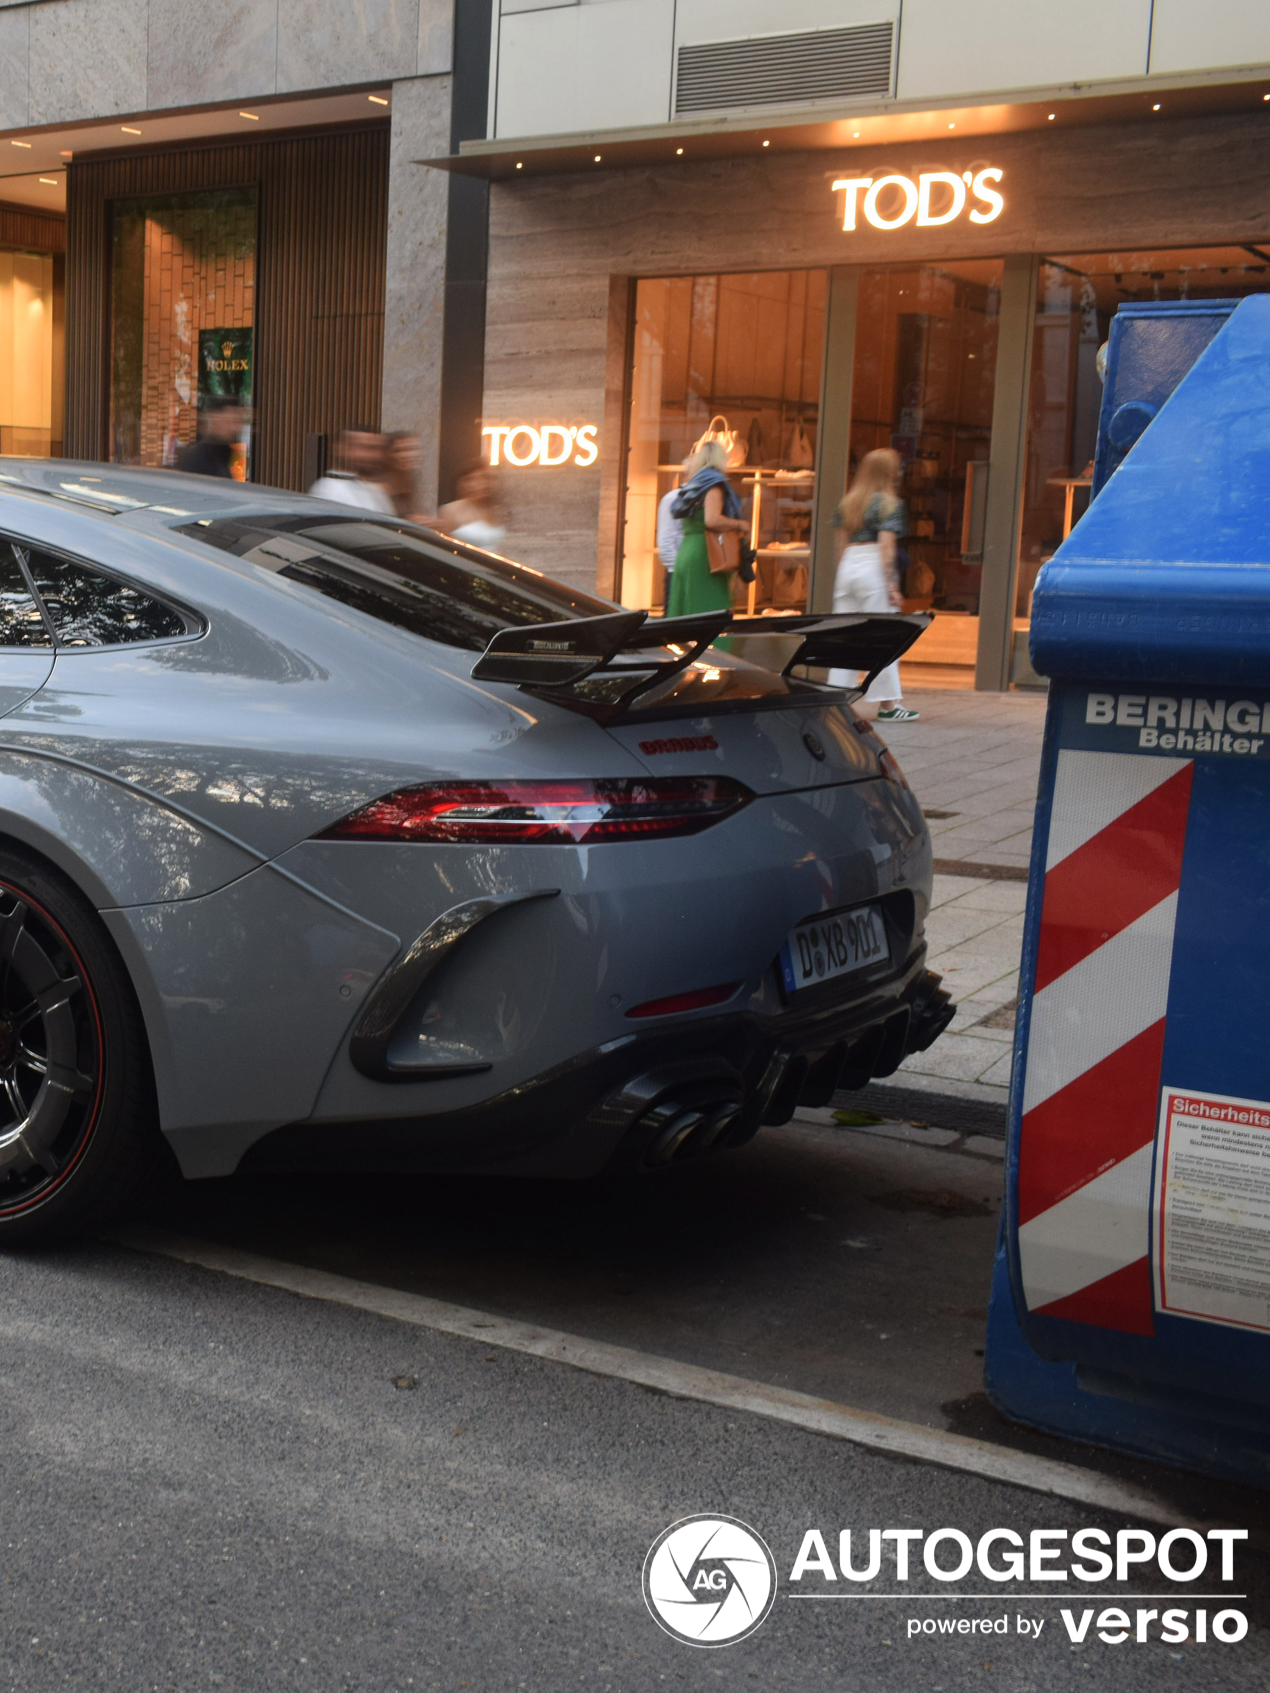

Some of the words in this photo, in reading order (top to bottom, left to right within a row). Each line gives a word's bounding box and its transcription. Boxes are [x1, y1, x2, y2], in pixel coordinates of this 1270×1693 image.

[832, 167, 1004, 231] TOD'S
[206, 359, 249, 372] ROLEX
[482, 425, 599, 467] TOD'S
[1085, 692, 1270, 735] BERING
[639, 735, 719, 756] BRABUS
[1139, 727, 1265, 755] Behälter
[796, 931, 813, 979] D
[821, 921, 848, 971] XB
